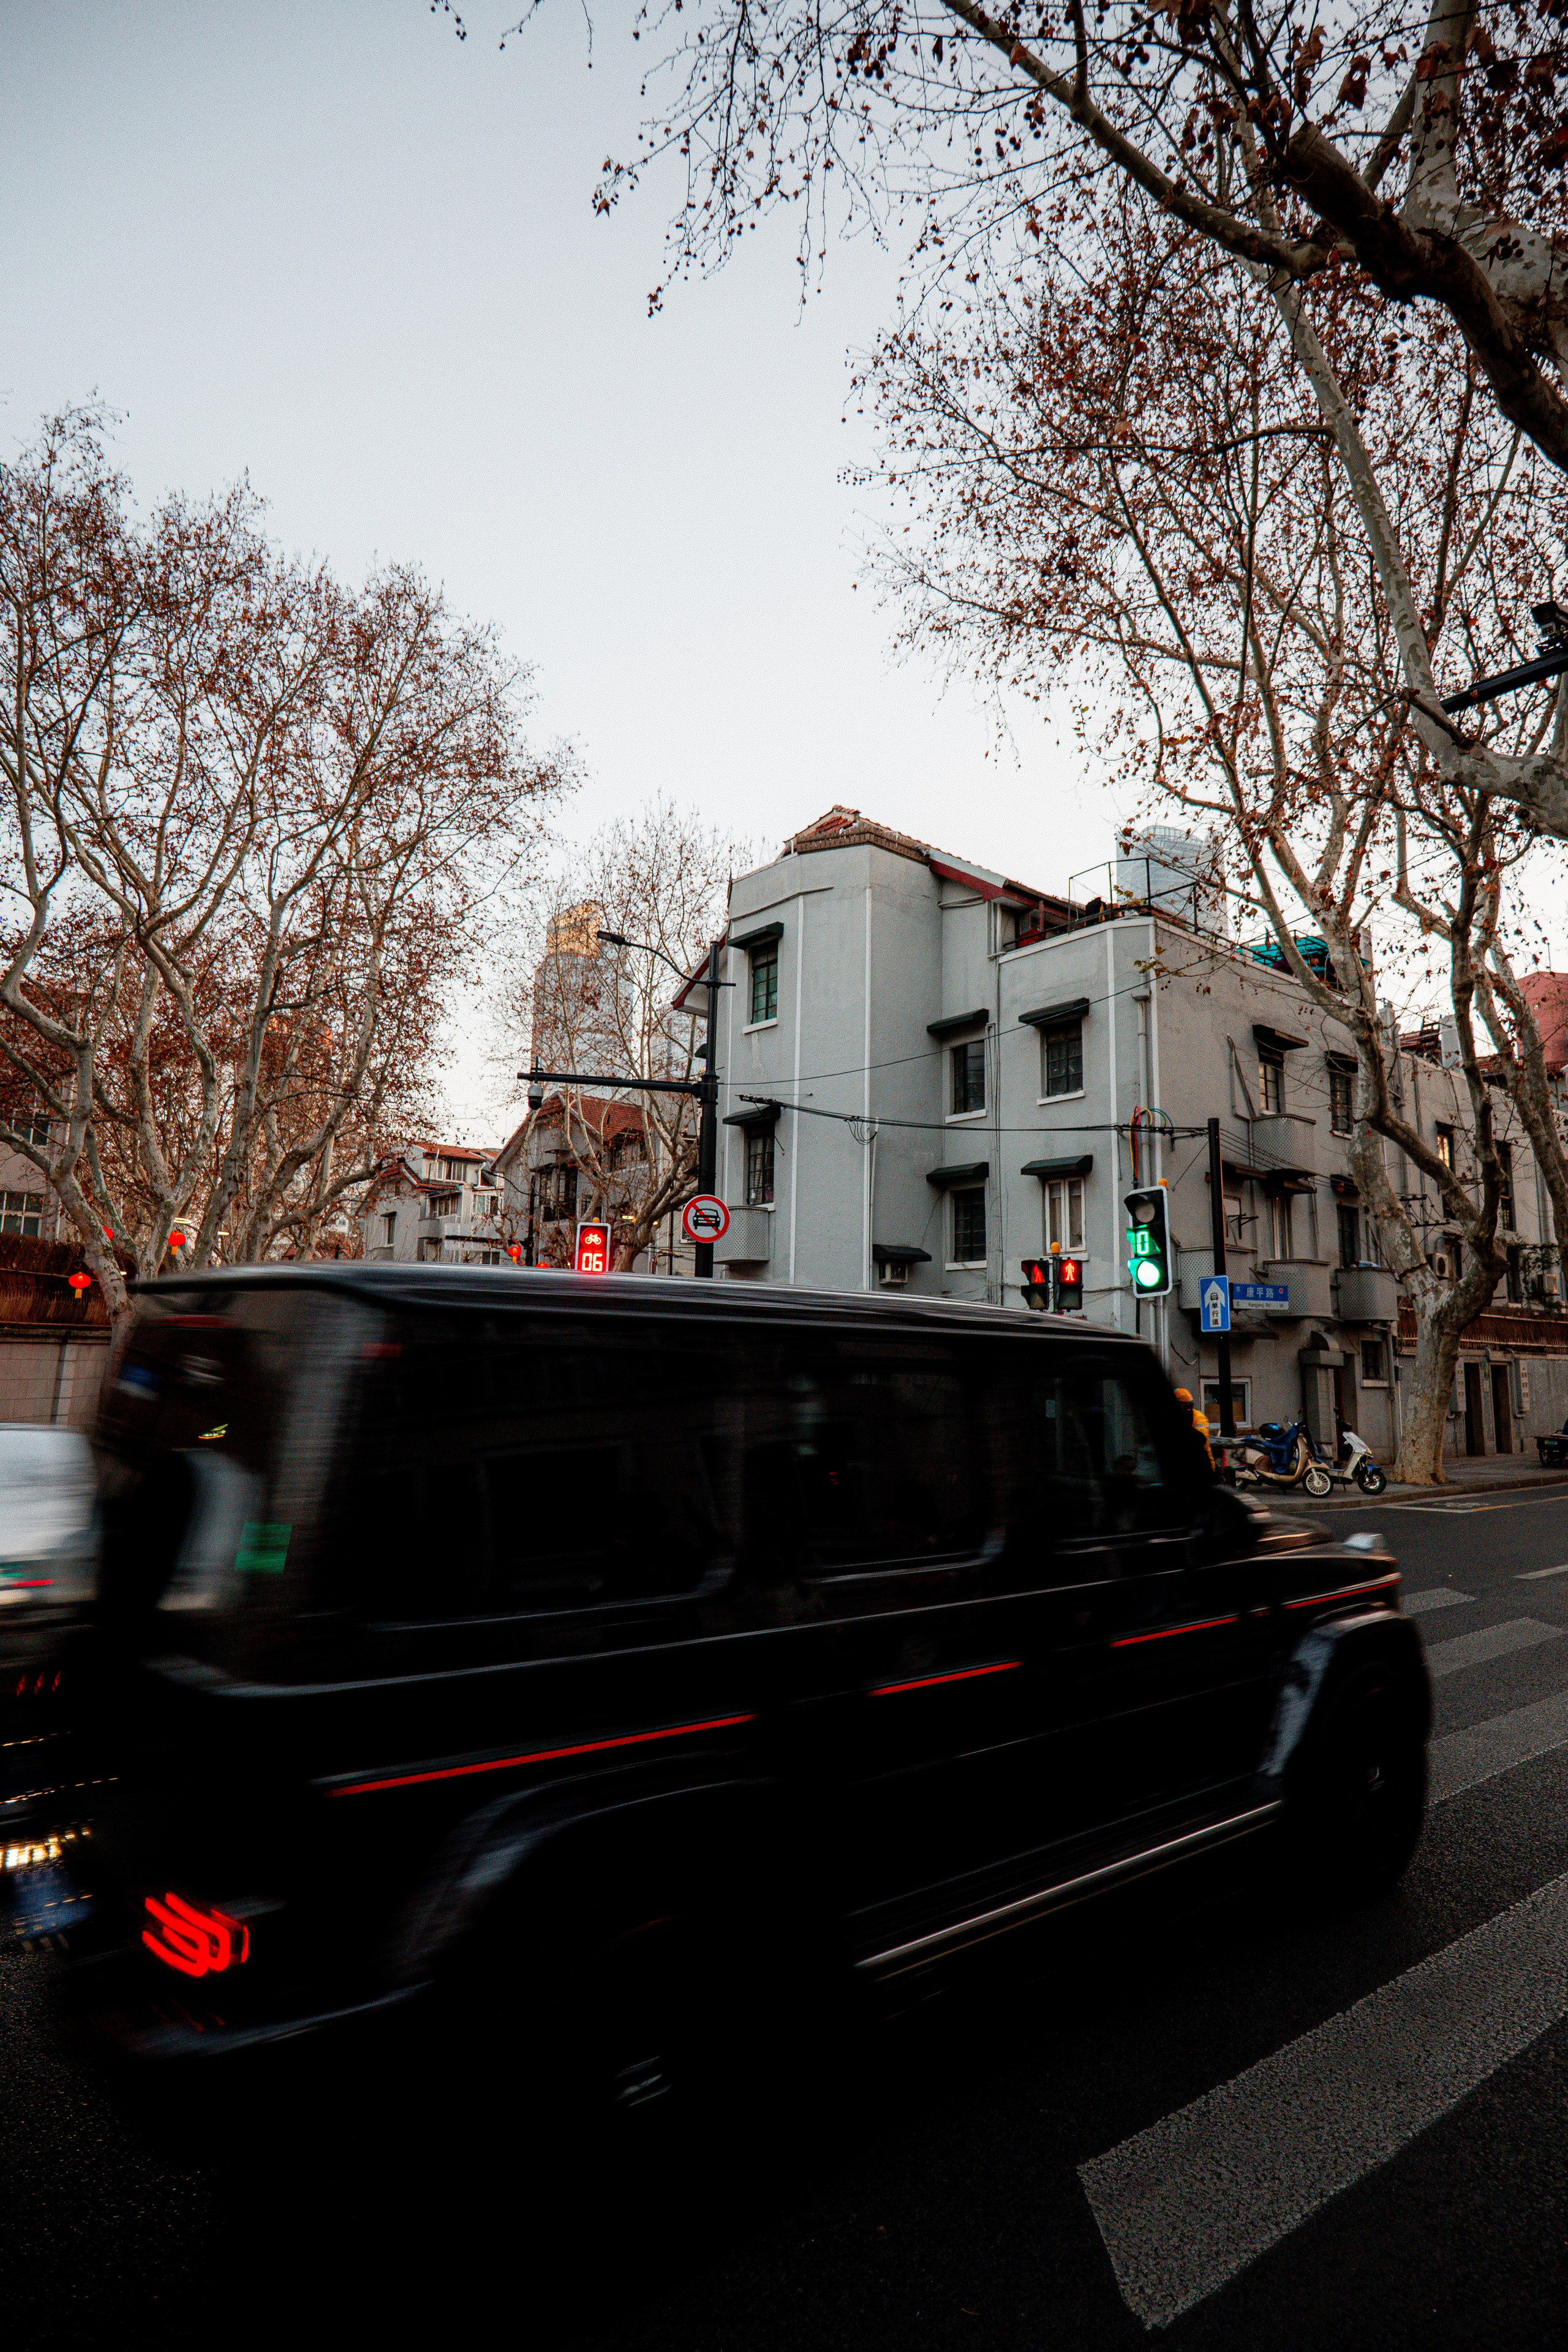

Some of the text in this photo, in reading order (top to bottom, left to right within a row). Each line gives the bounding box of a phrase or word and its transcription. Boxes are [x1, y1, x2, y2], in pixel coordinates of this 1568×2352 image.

[582, 1253, 603, 1272] 06
[1246, 1287, 1273, 1298] 康平路
